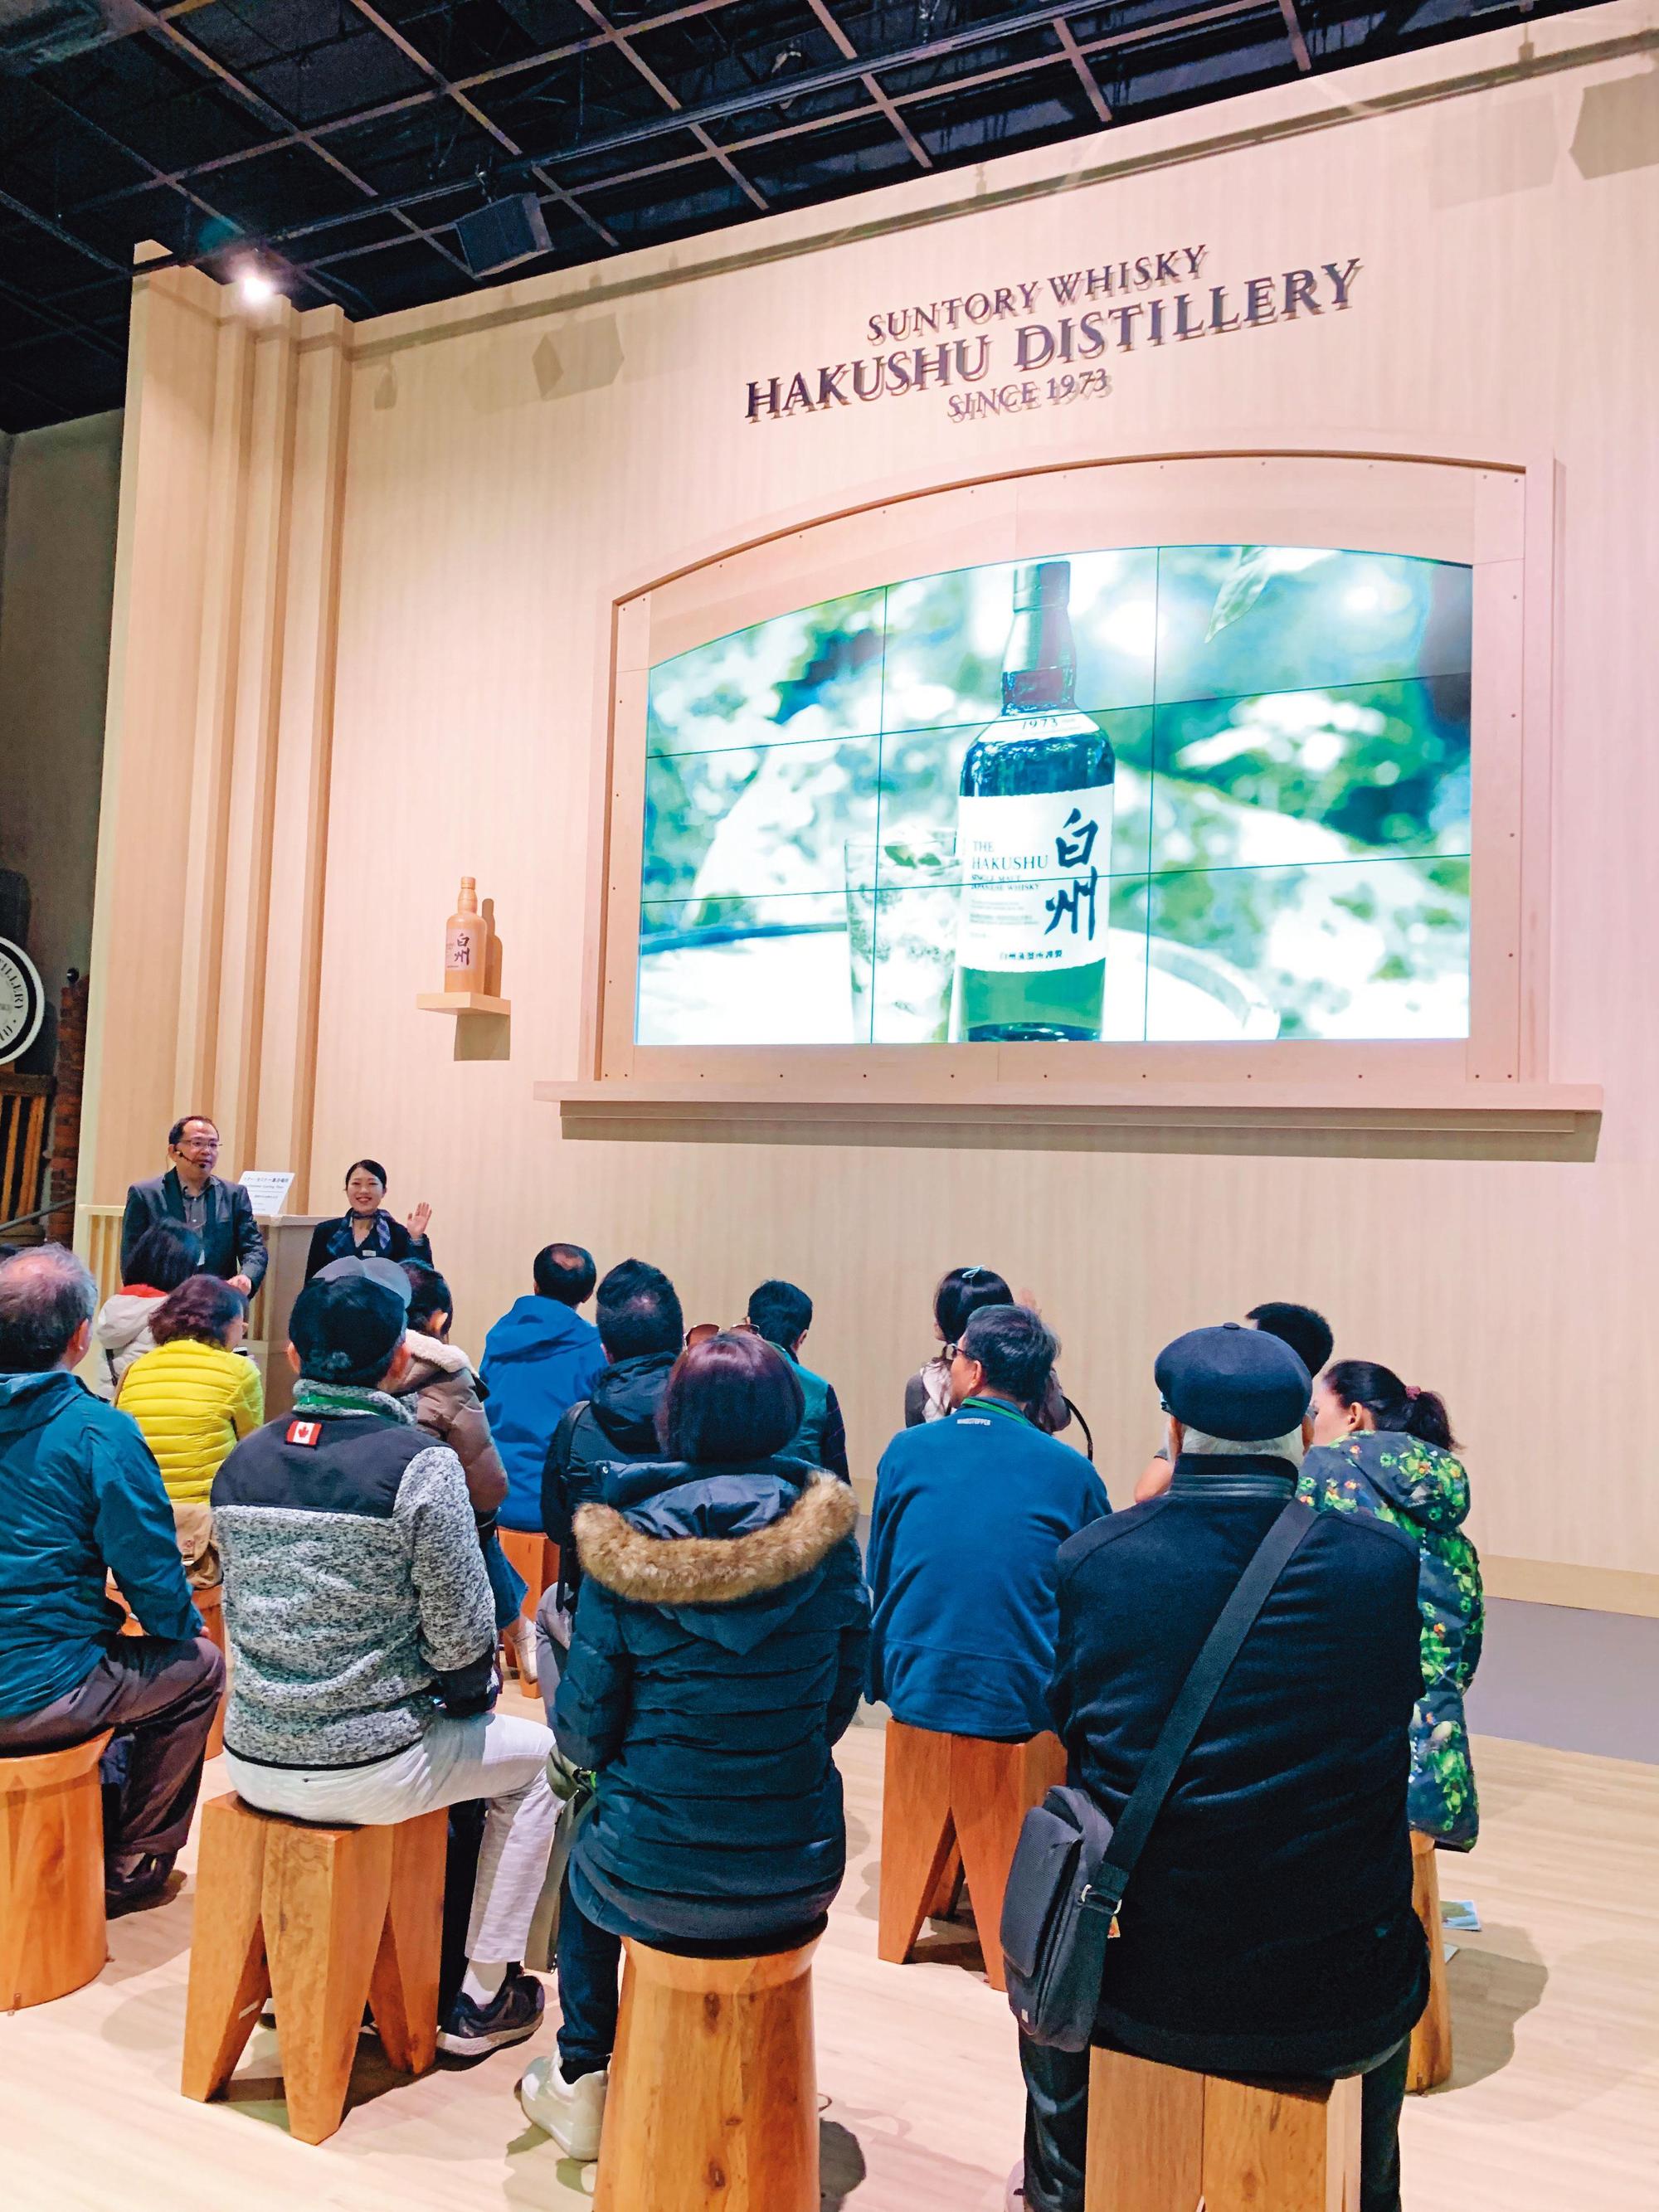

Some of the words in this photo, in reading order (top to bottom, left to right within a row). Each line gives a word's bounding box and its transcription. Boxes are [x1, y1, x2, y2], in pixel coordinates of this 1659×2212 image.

[868, 280, 1039, 343] SUNTORY
[1047, 244, 1207, 304] WHISKY
[745, 334, 990, 421] HAKUSHU
[1014, 258, 1362, 368] DISTILLERY
[947, 381, 1039, 419] SINCE
[1047, 368, 1110, 401] 1973
[1022, 717, 1058, 731] 1973
[972, 854, 1048, 870] HAKUSHU
[973, 841, 995, 853] THE
[1008, 882, 1039, 892] WHISKY
[1044, 808, 1098, 941] 白州
[454, 932, 470, 965] 白州
